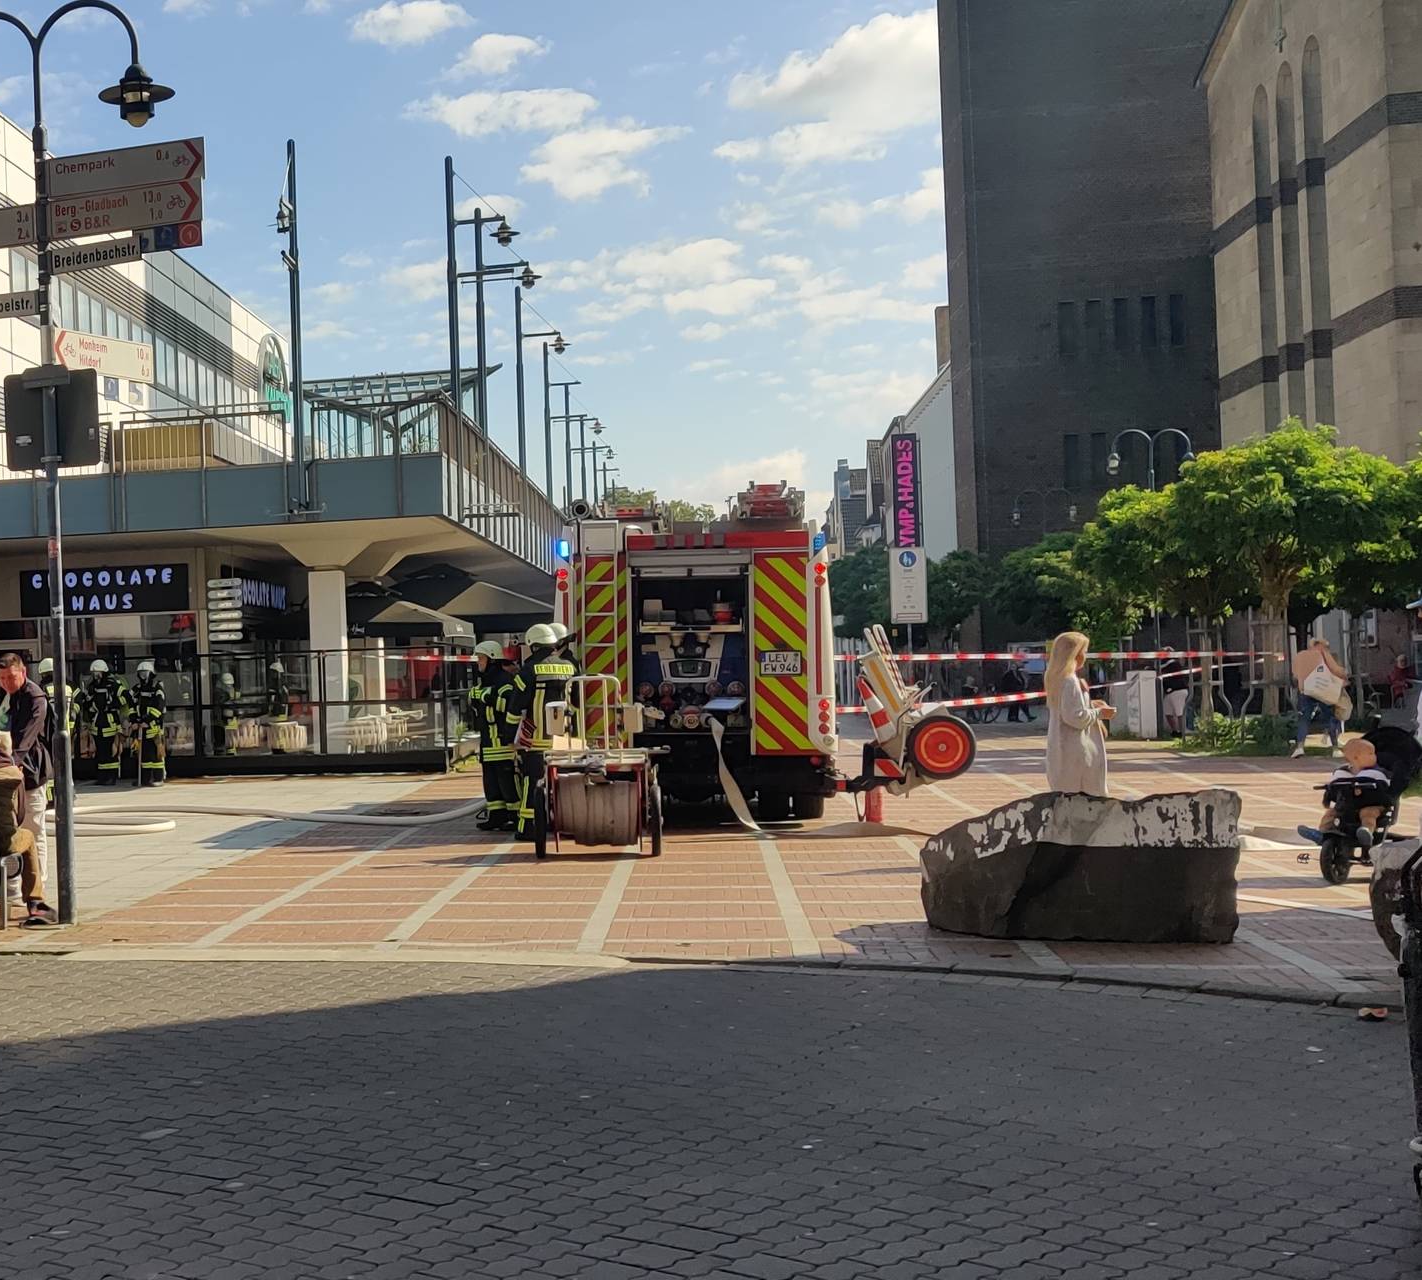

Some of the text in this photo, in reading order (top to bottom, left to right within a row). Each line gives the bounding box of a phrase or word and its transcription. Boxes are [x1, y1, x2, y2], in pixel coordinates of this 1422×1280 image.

[55, 157, 115, 175] Chempark
[55, 195, 129, 218] Berg.-Gladbach
[84, 214, 111, 230] B&R
[54, 243, 139, 269] Breidenbachstr.
[79, 337, 108, 354] Monheim
[31, 567, 173, 590] COCOLATE
[71, 593, 134, 612] HAUS
[769, 653, 788, 663] LEV
